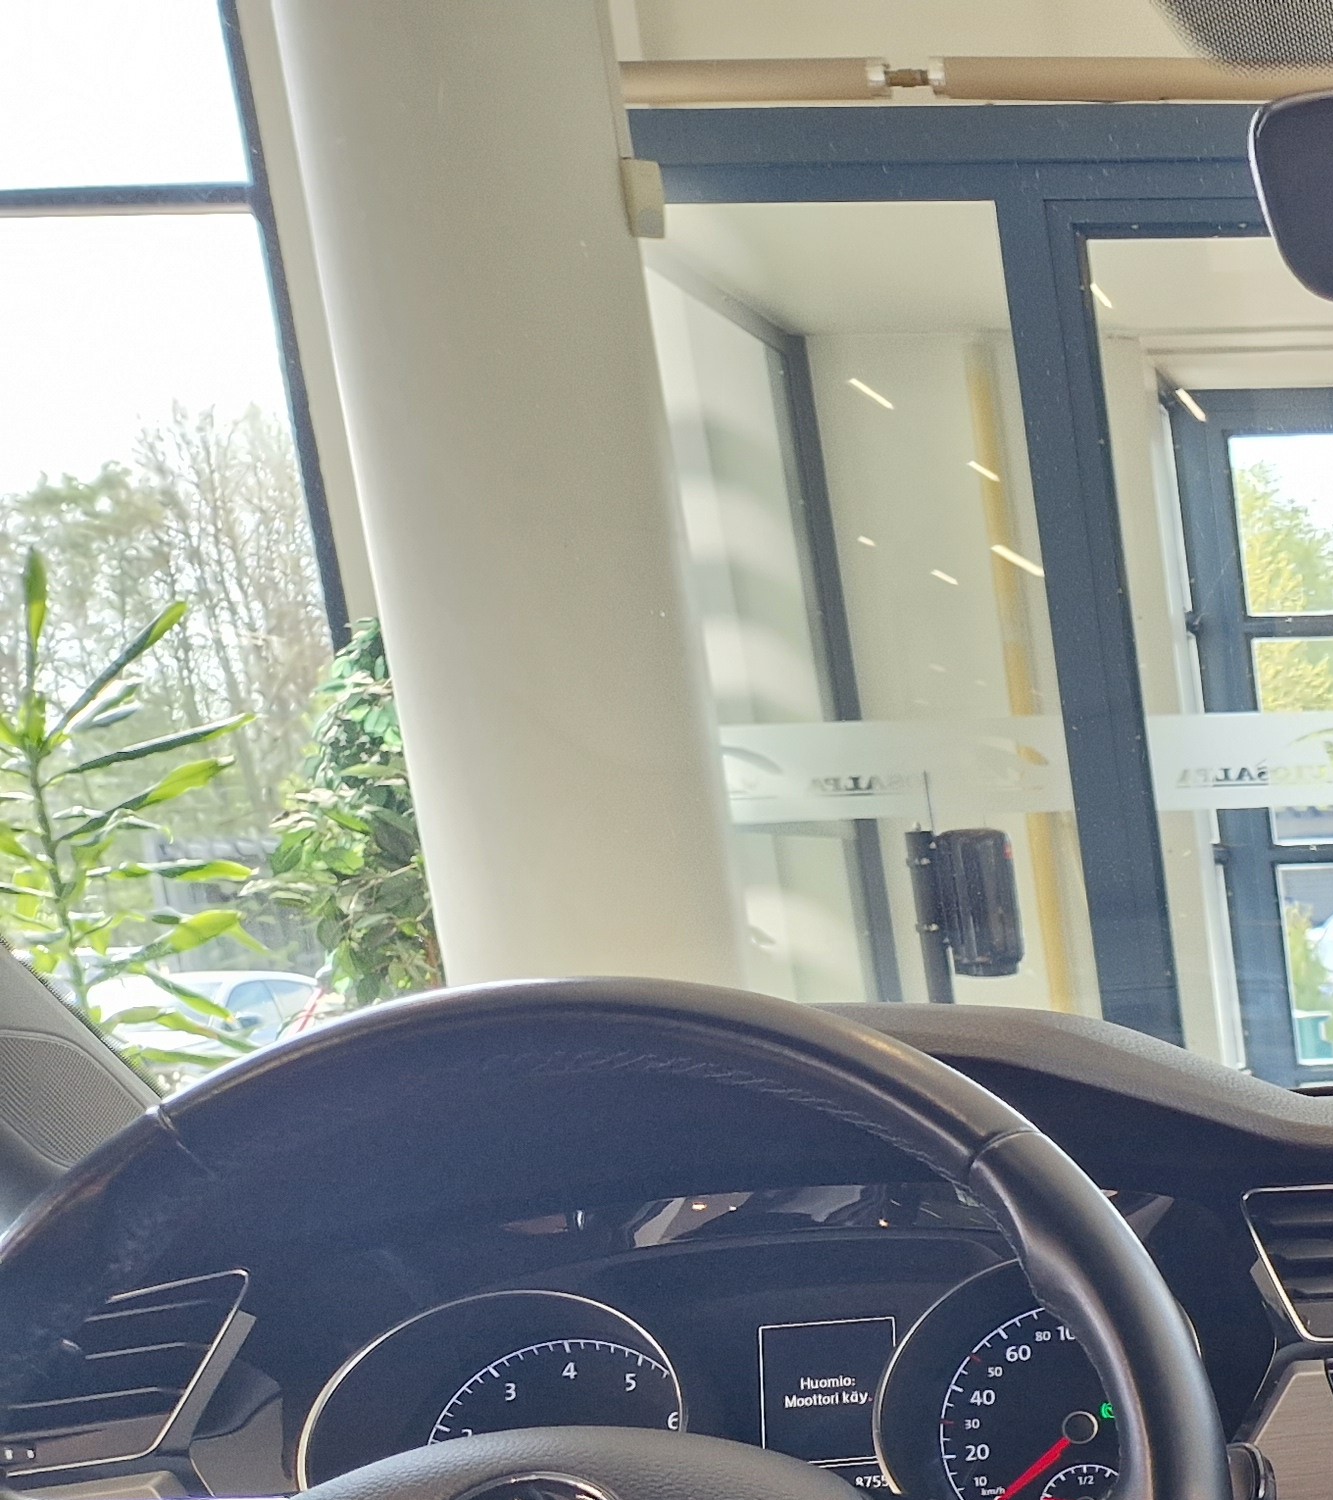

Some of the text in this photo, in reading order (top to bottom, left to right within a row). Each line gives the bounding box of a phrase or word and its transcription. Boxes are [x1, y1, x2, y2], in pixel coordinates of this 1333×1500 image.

[1034, 1330, 1051, 1342] 80
[1005, 1344, 1031, 1362] 60
[562, 1361, 577, 1380] 4
[986, 1366, 1003, 1378] 50
[624, 1373, 637, 1392] 5
[800, 1375, 856, 1391] Huomio:
[504, 1382, 517, 1401] 3
[969, 1389, 996, 1407] 40
[784, 1393, 839, 1409] Moottori
[964, 1418, 980, 1430] 30
[964, 1443, 990, 1462] 20
[973, 1475, 988, 1488] 10
[1077, 1474, 1094, 1486] 1/2
[981, 1486, 1006, 1497] km/h
